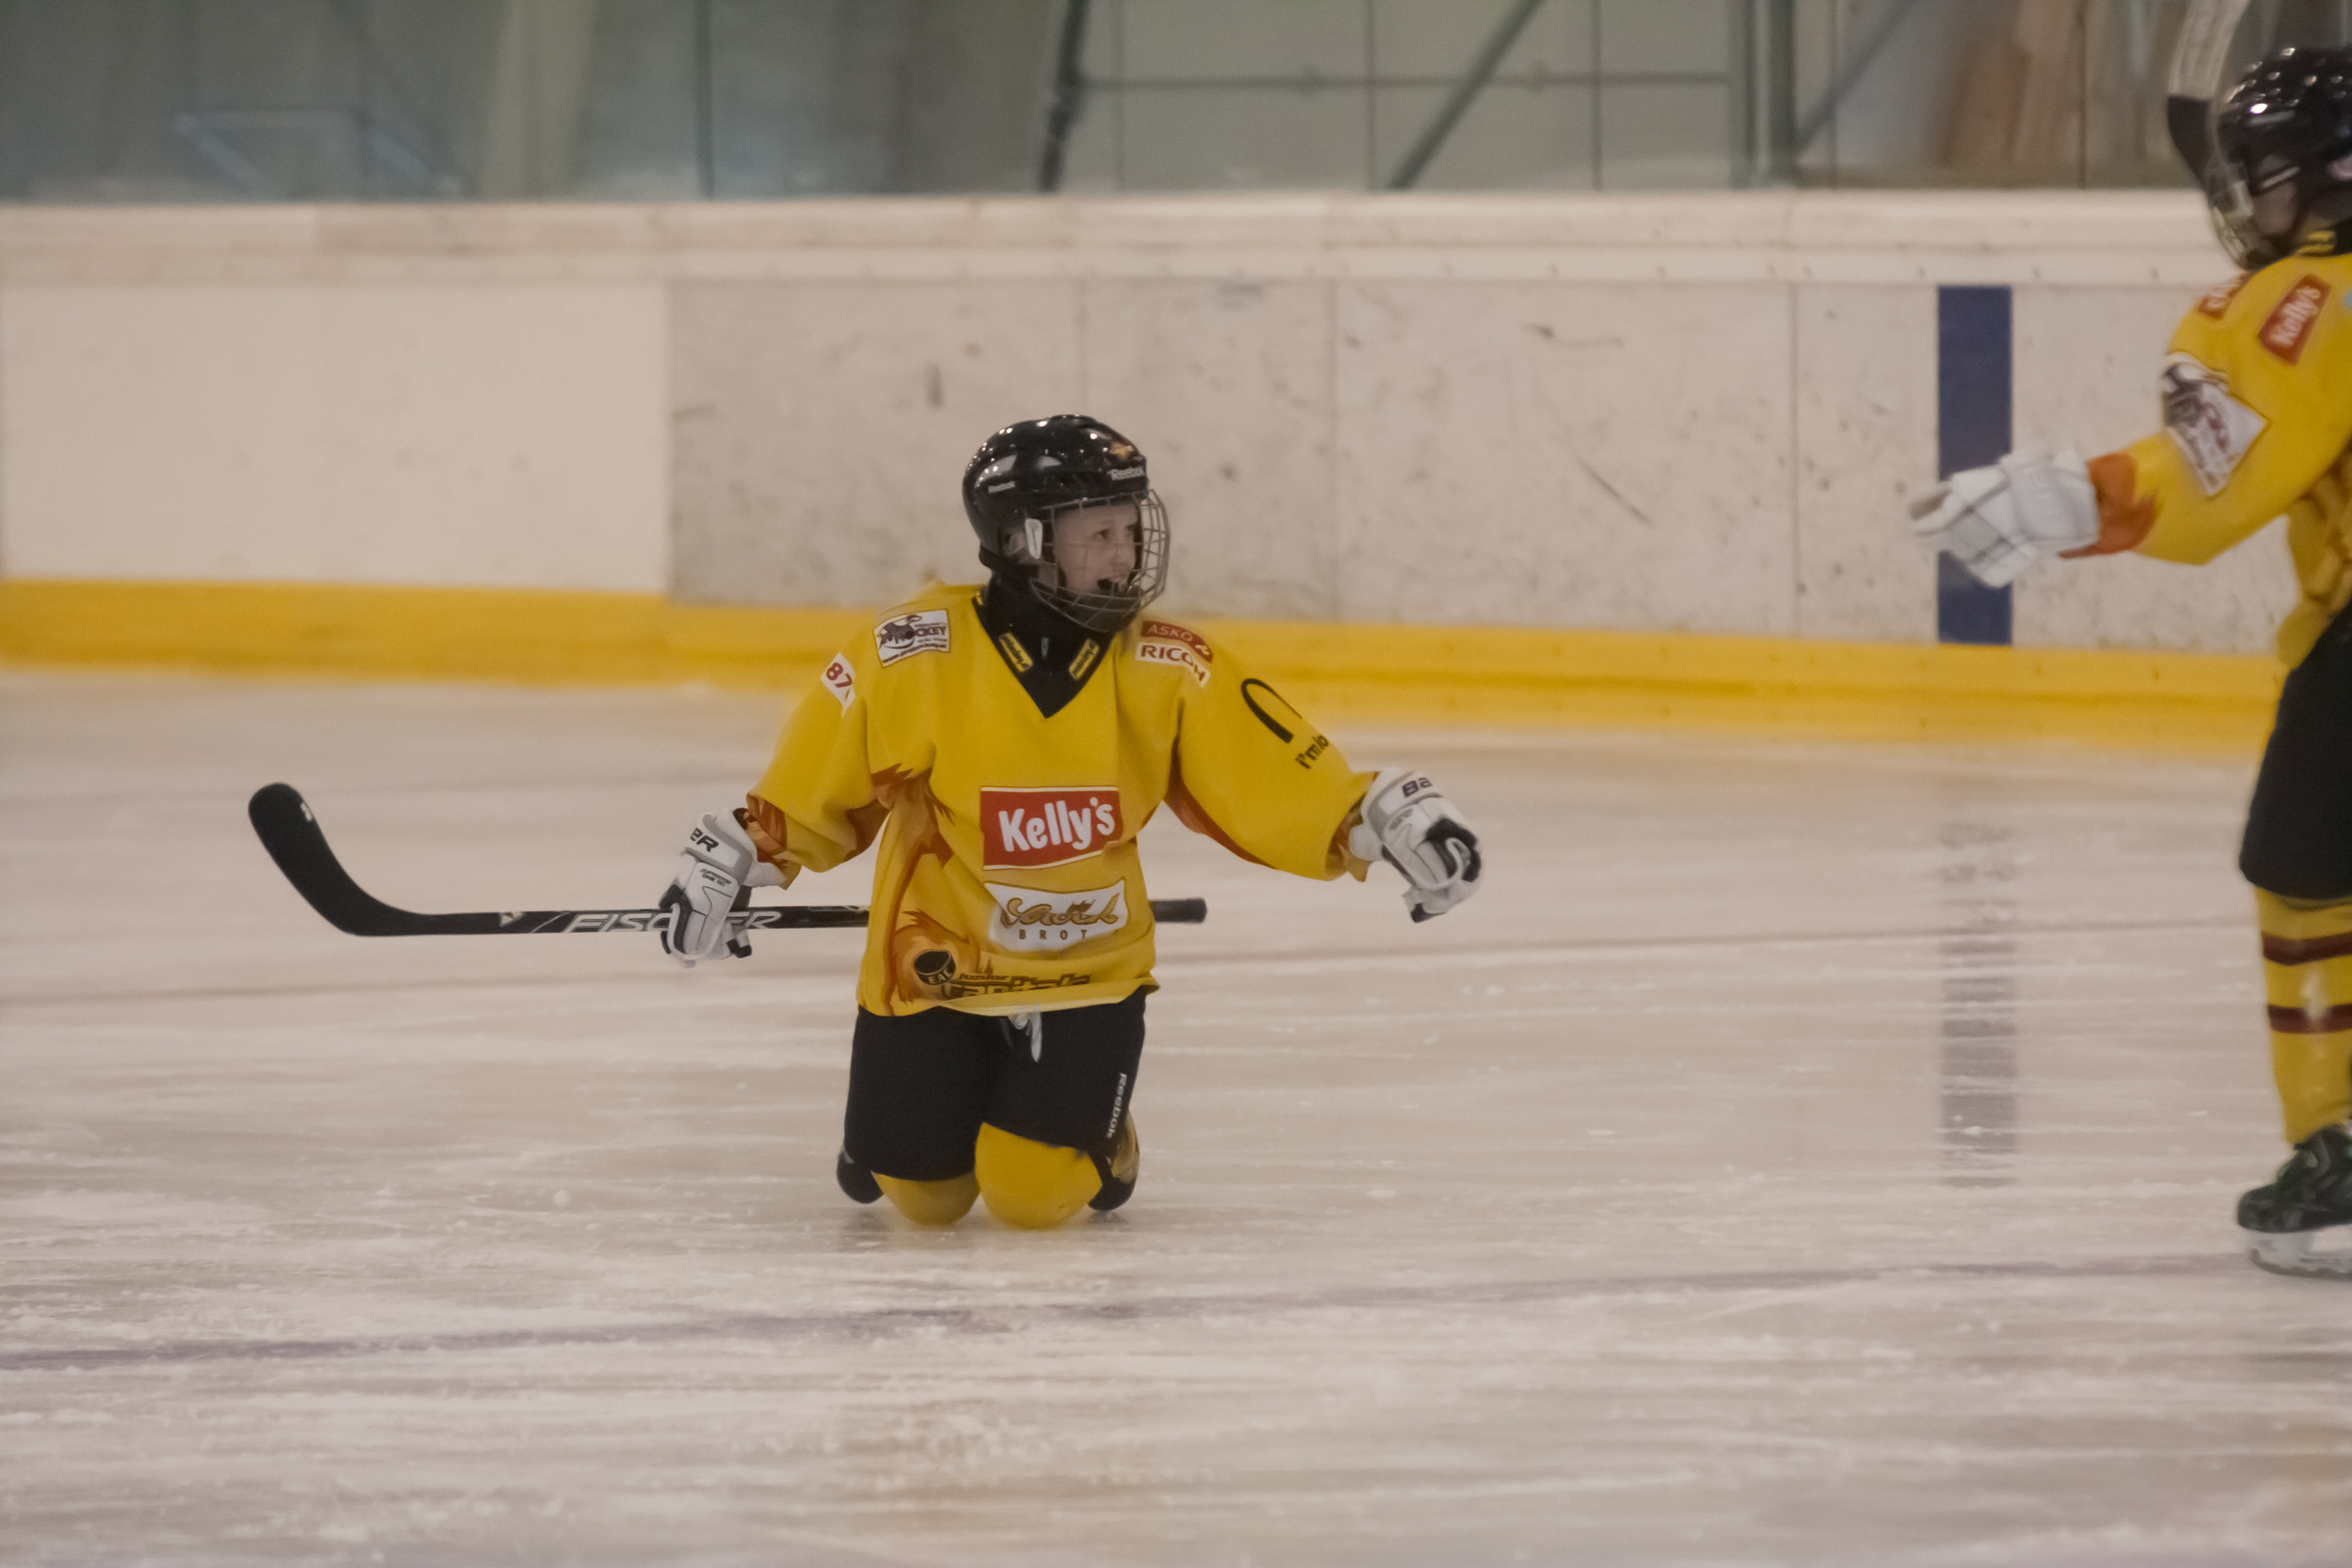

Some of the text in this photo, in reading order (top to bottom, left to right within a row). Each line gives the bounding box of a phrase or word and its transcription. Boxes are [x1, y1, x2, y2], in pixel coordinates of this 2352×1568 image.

[1141, 644, 1206, 682] RICOH
[998, 797, 1116, 852] Kelly's
[564, 910, 783, 934] FISCER
[1019, 929, 1088, 940] BROT
